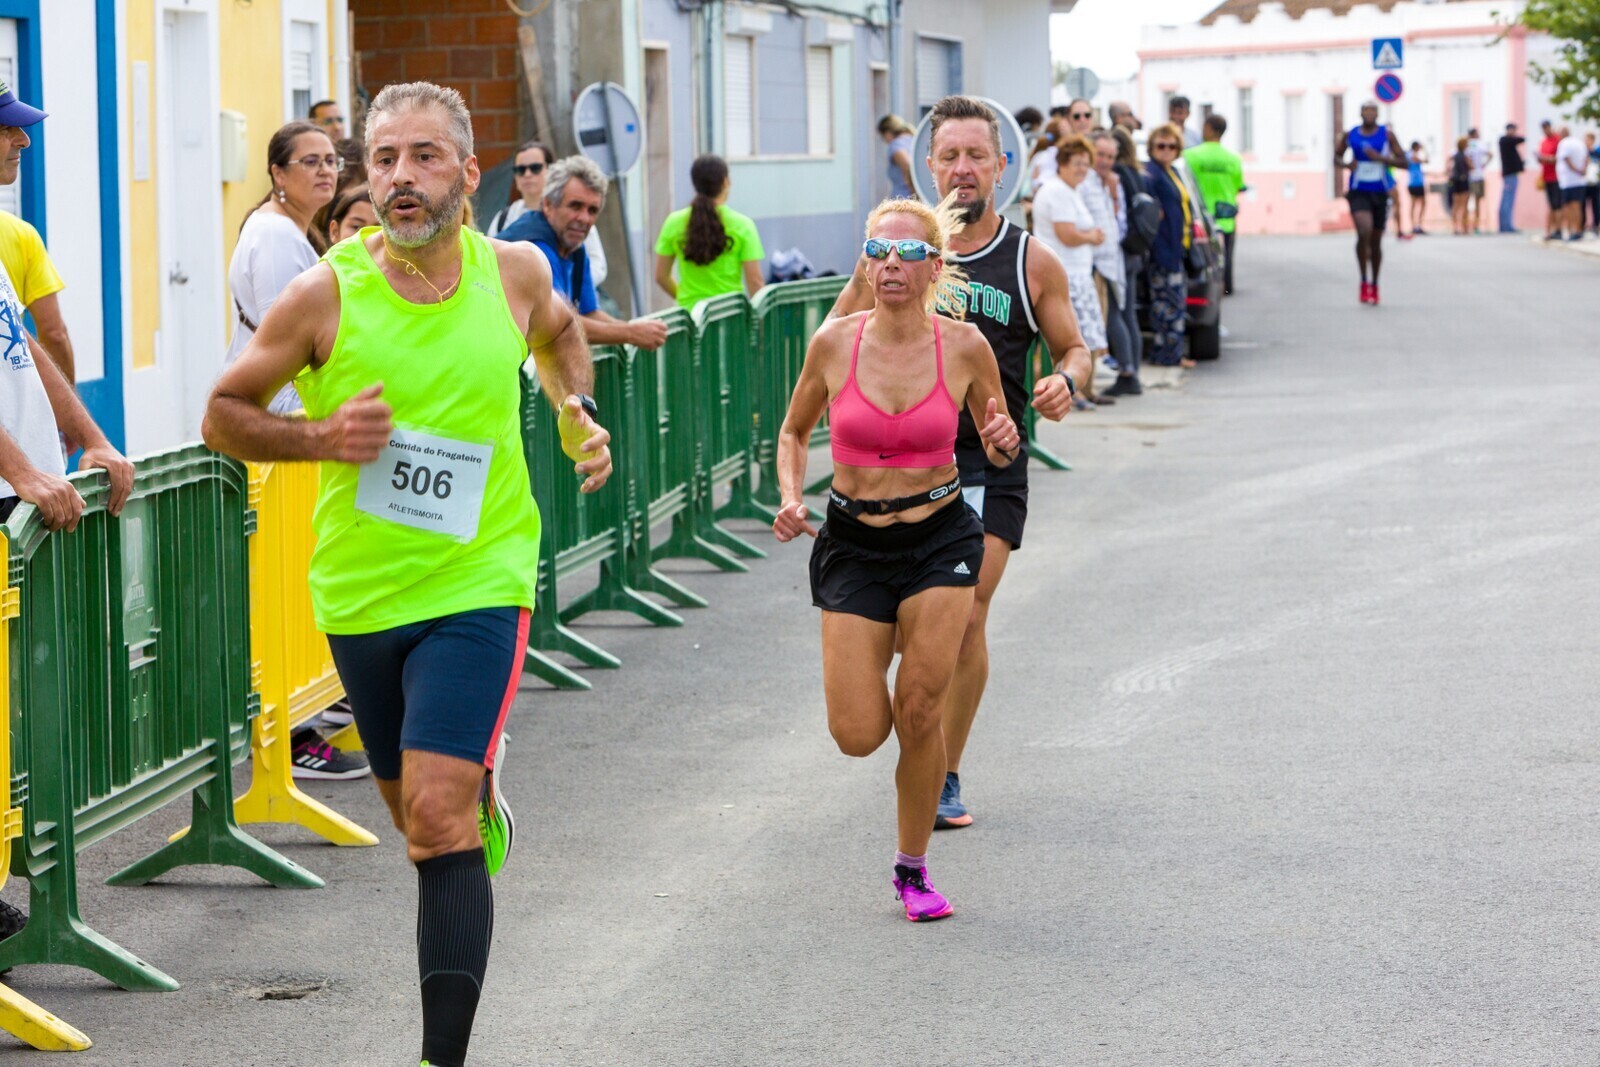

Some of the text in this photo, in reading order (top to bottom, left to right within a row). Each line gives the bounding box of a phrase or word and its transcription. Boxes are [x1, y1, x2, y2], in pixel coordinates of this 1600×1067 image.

[926, 281, 1011, 327] OSTON
[389, 439, 482, 464] Corrida do Fragateiro
[391, 460, 453, 499] 506
[388, 502, 443, 521] ATLETISMOITA
